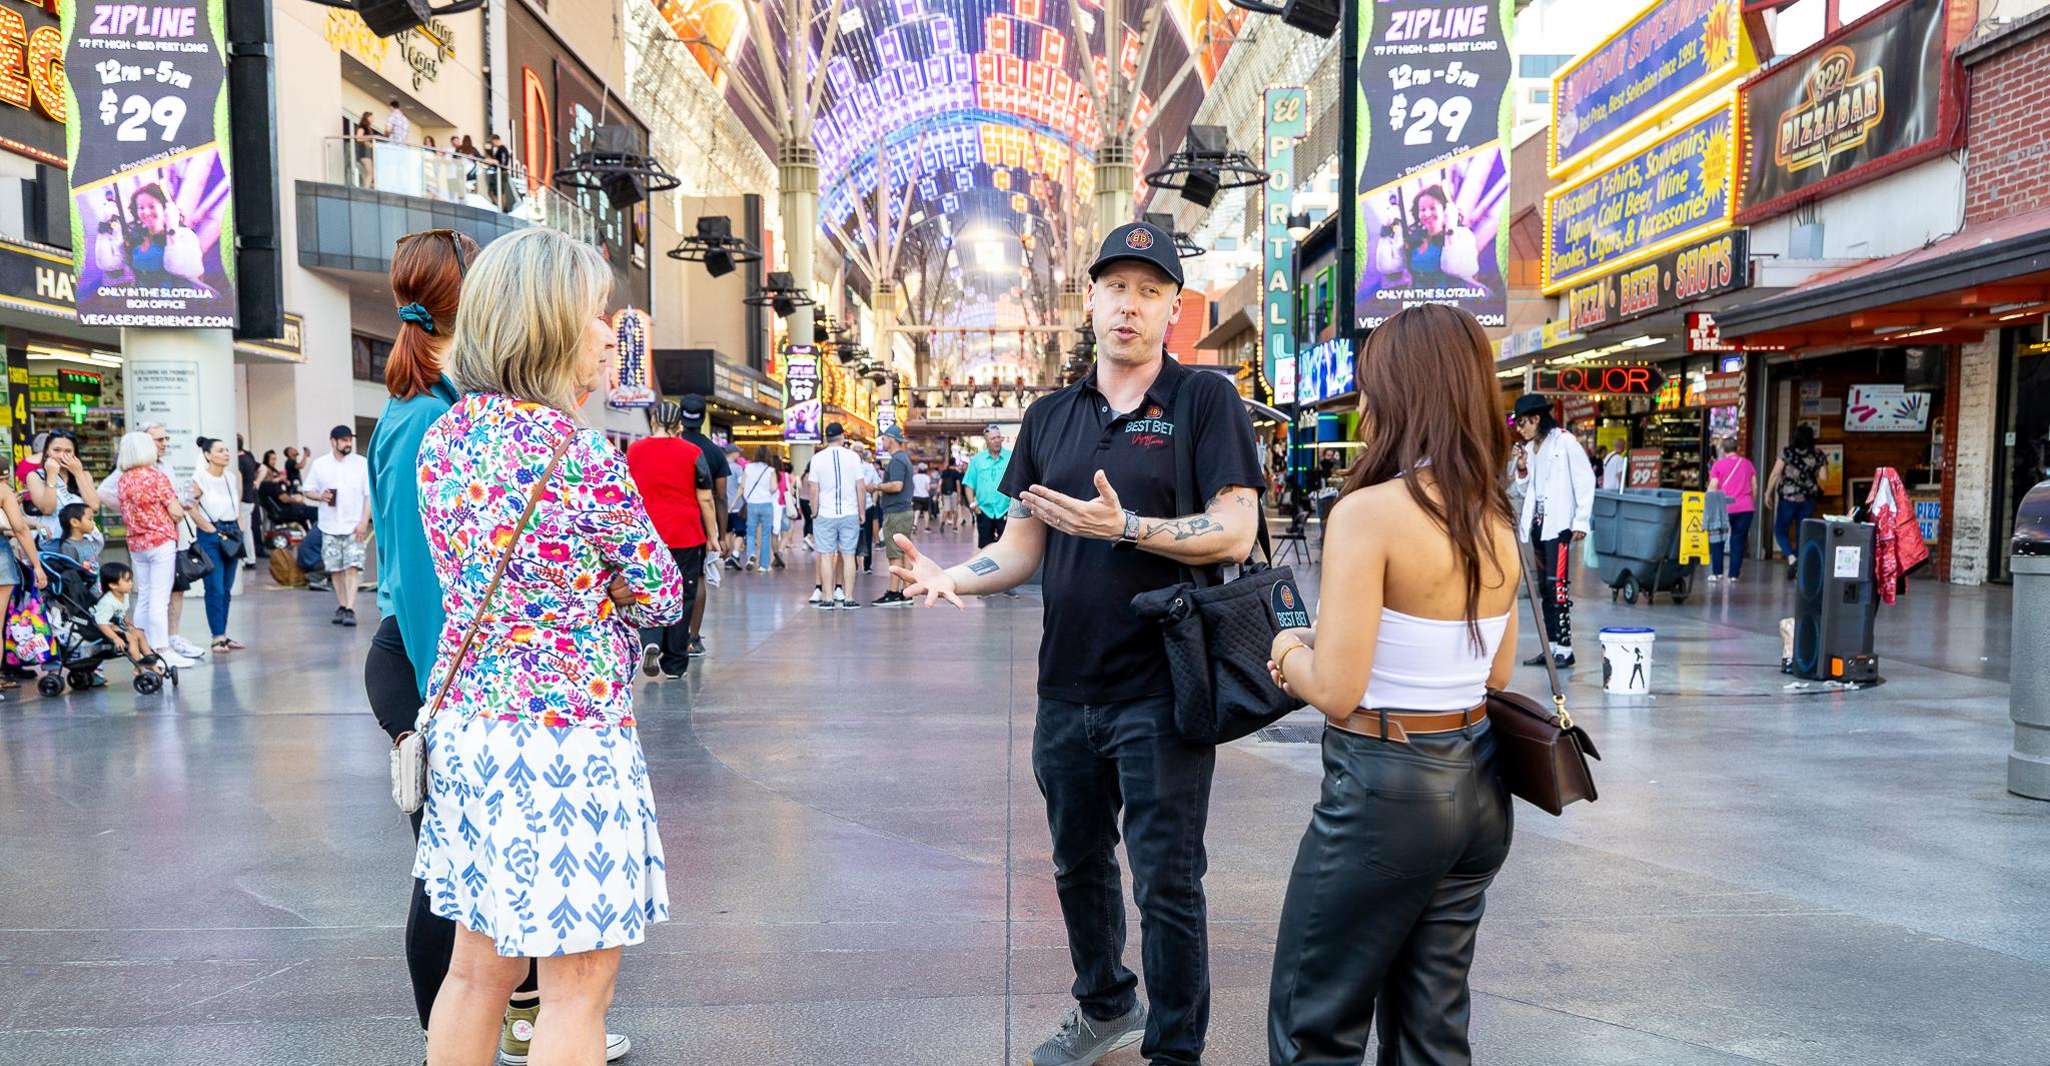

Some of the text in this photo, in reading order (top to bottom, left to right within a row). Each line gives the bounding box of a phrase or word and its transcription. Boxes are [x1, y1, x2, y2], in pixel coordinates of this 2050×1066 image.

[89, 4, 197, 38] ZIPLINE
[1384, 5, 1488, 42] ZIPLINE
[180, 43, 208, 54] LONG
[1400, 44, 1423, 55] HIGH
[1447, 41, 1470, 53] FEET
[1470, 40, 1498, 51] LONG
[1677, 37, 1698, 70] 1991
[1814, 58, 1846, 102] 922
[98, 87, 188, 143] $29
[1272, 97, 1298, 123] El
[1388, 92, 1473, 146] $29
[1452, 144, 1470, 157] Fee
[1597, 193, 1625, 228] Cold
[1655, 168, 1690, 204] Wine
[1268, 135, 1291, 326] PORTAL
[1624, 218, 1636, 248] &
[35, 265, 77, 303] HA
[97, 286, 126, 297] ONLY
[126, 287, 139, 297] IN
[139, 287, 160, 298] THE
[1375, 289, 1404, 300] ONLY
[1403, 289, 1416, 299] IN
[1416, 288, 1435, 299] THE
[1569, 236, 1733, 335] PIZZA BEER SHOTS
[126, 299, 187, 310] BOX OFFICE
[79, 313, 234, 327] VEGASEXPERIENCE.COM
[1537, 367, 1650, 393] LIQUOR
[1125, 419, 1175, 436] BEST BET
[1916, 501, 1942, 519] PIZZ
[1276, 611, 1296, 627] BEST
